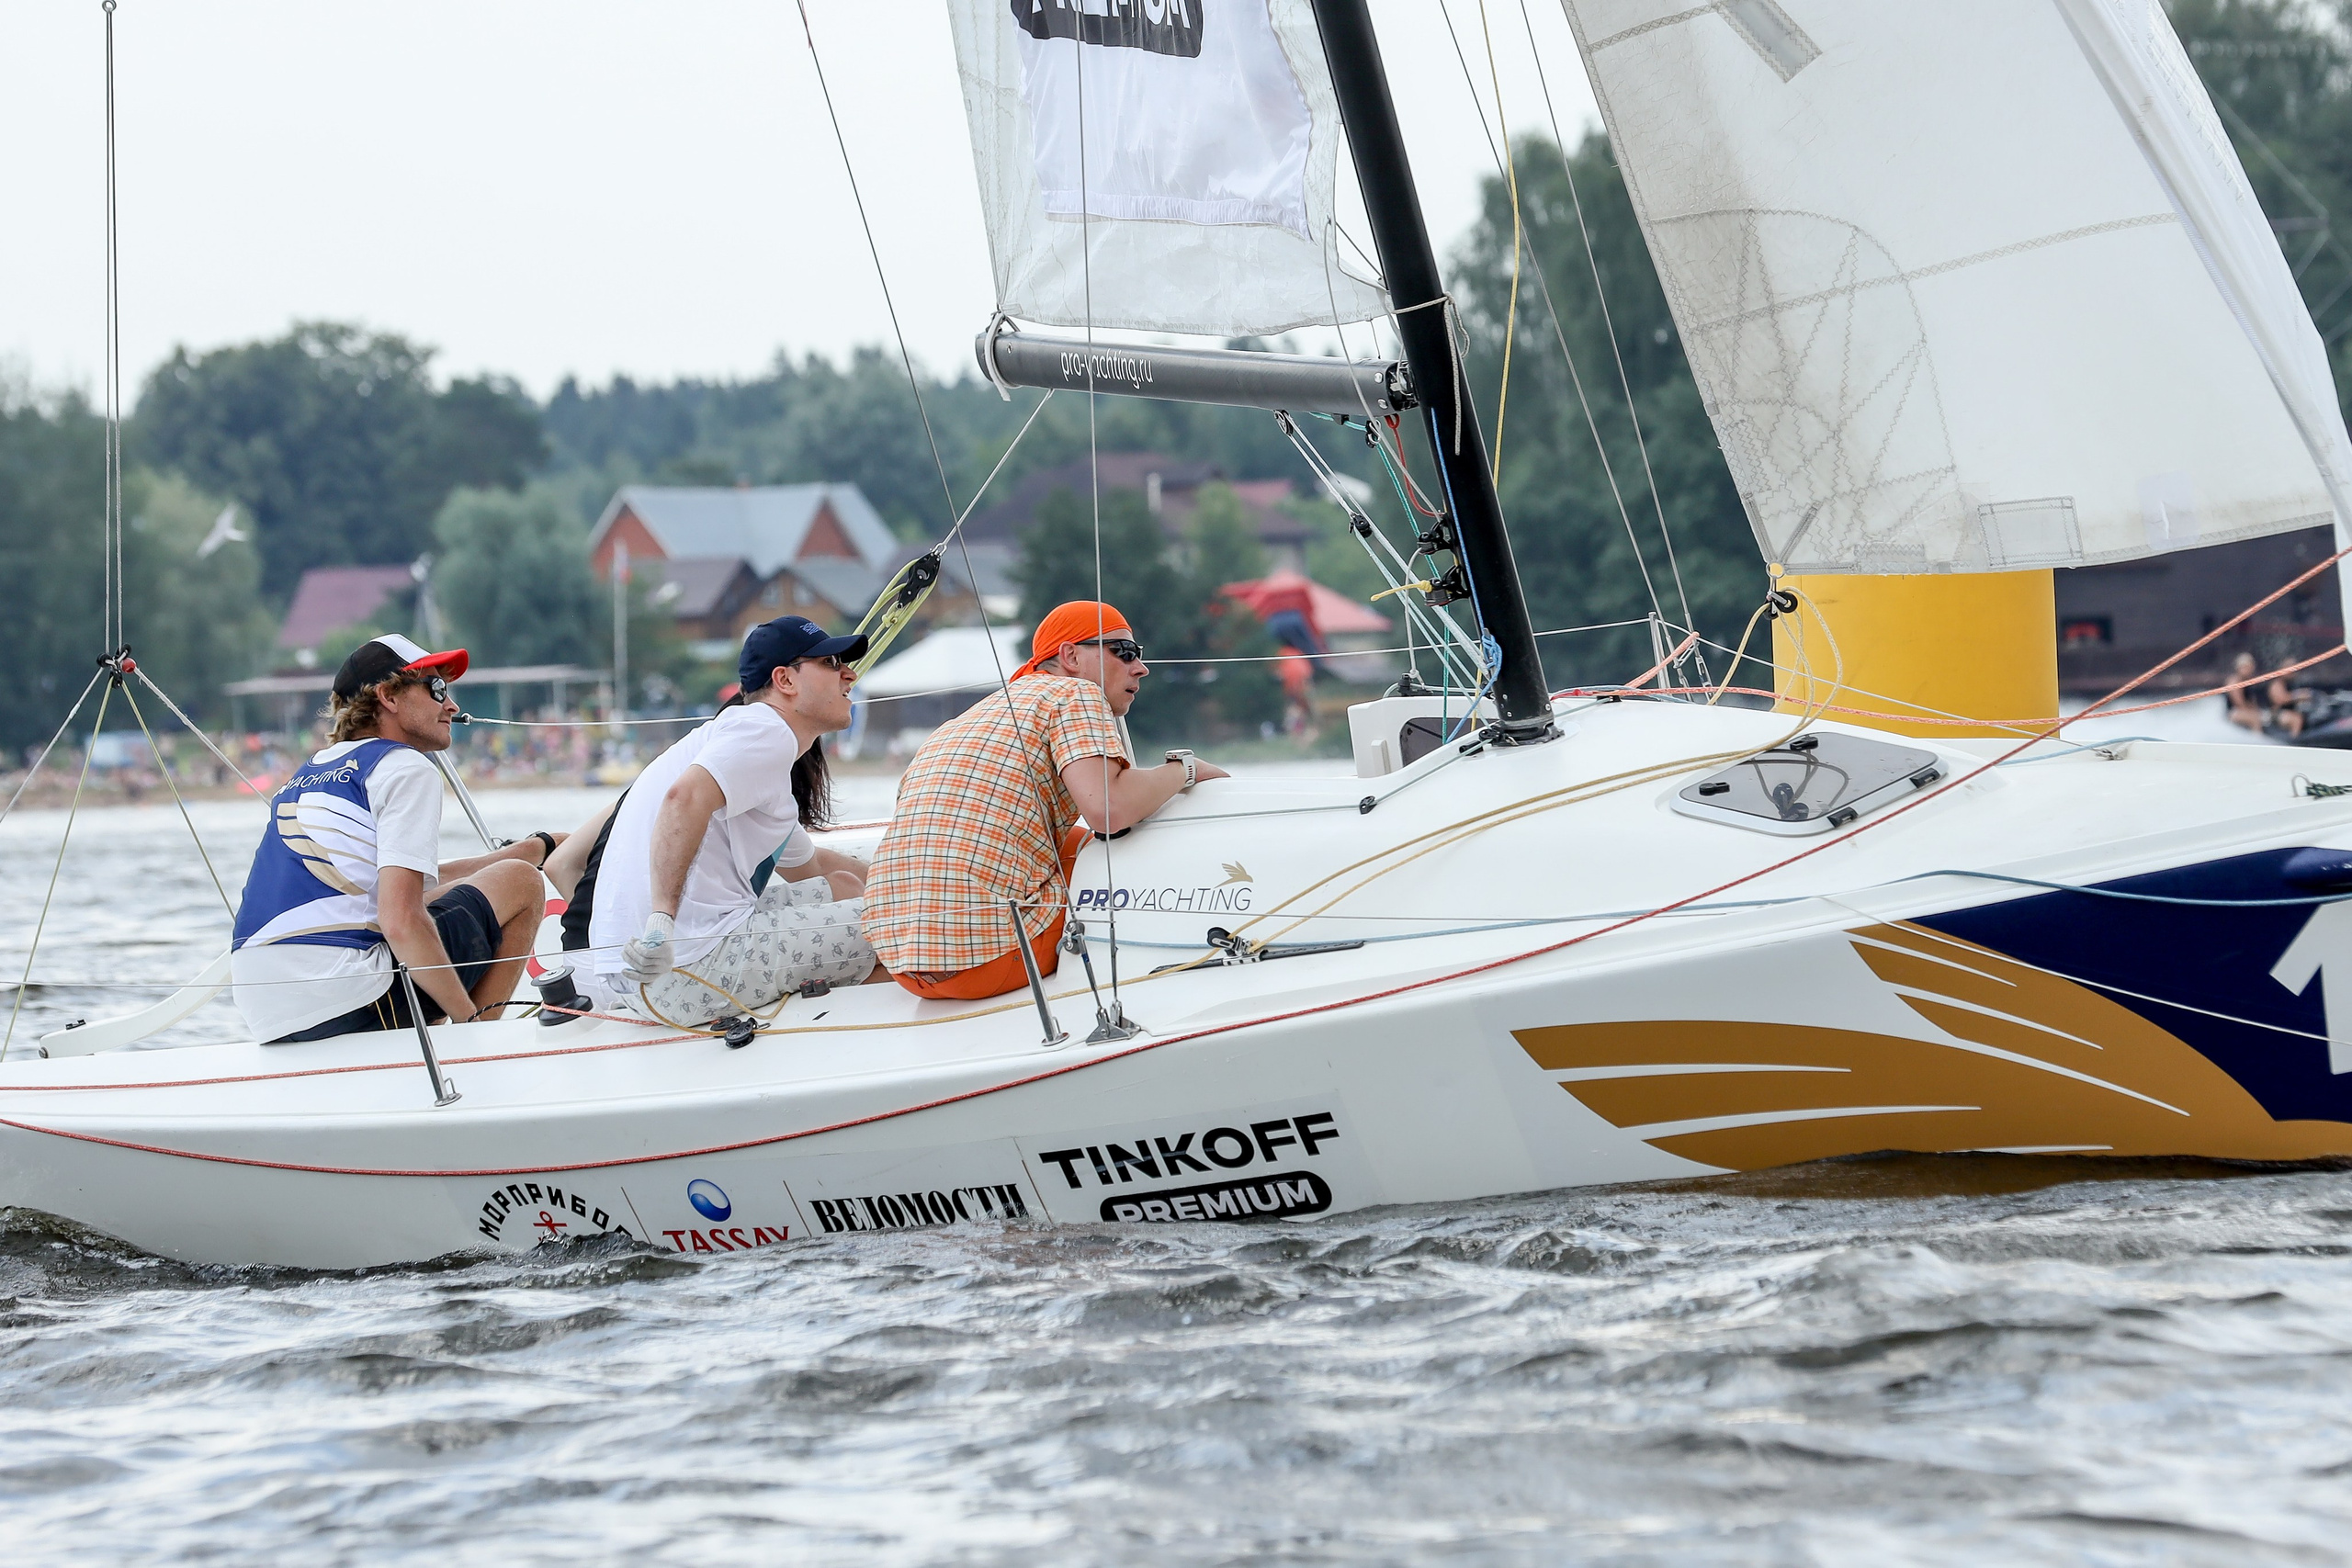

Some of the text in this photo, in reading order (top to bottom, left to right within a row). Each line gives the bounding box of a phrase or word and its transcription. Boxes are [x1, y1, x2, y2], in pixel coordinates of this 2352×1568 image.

[1060, 348, 1153, 389] pro-yachting.ru
[1076, 887, 1252, 911] PROYACHTING
[1038, 1111, 1340, 1189] TINKOFF
[1112, 1179, 1319, 1223] PREMIUM
